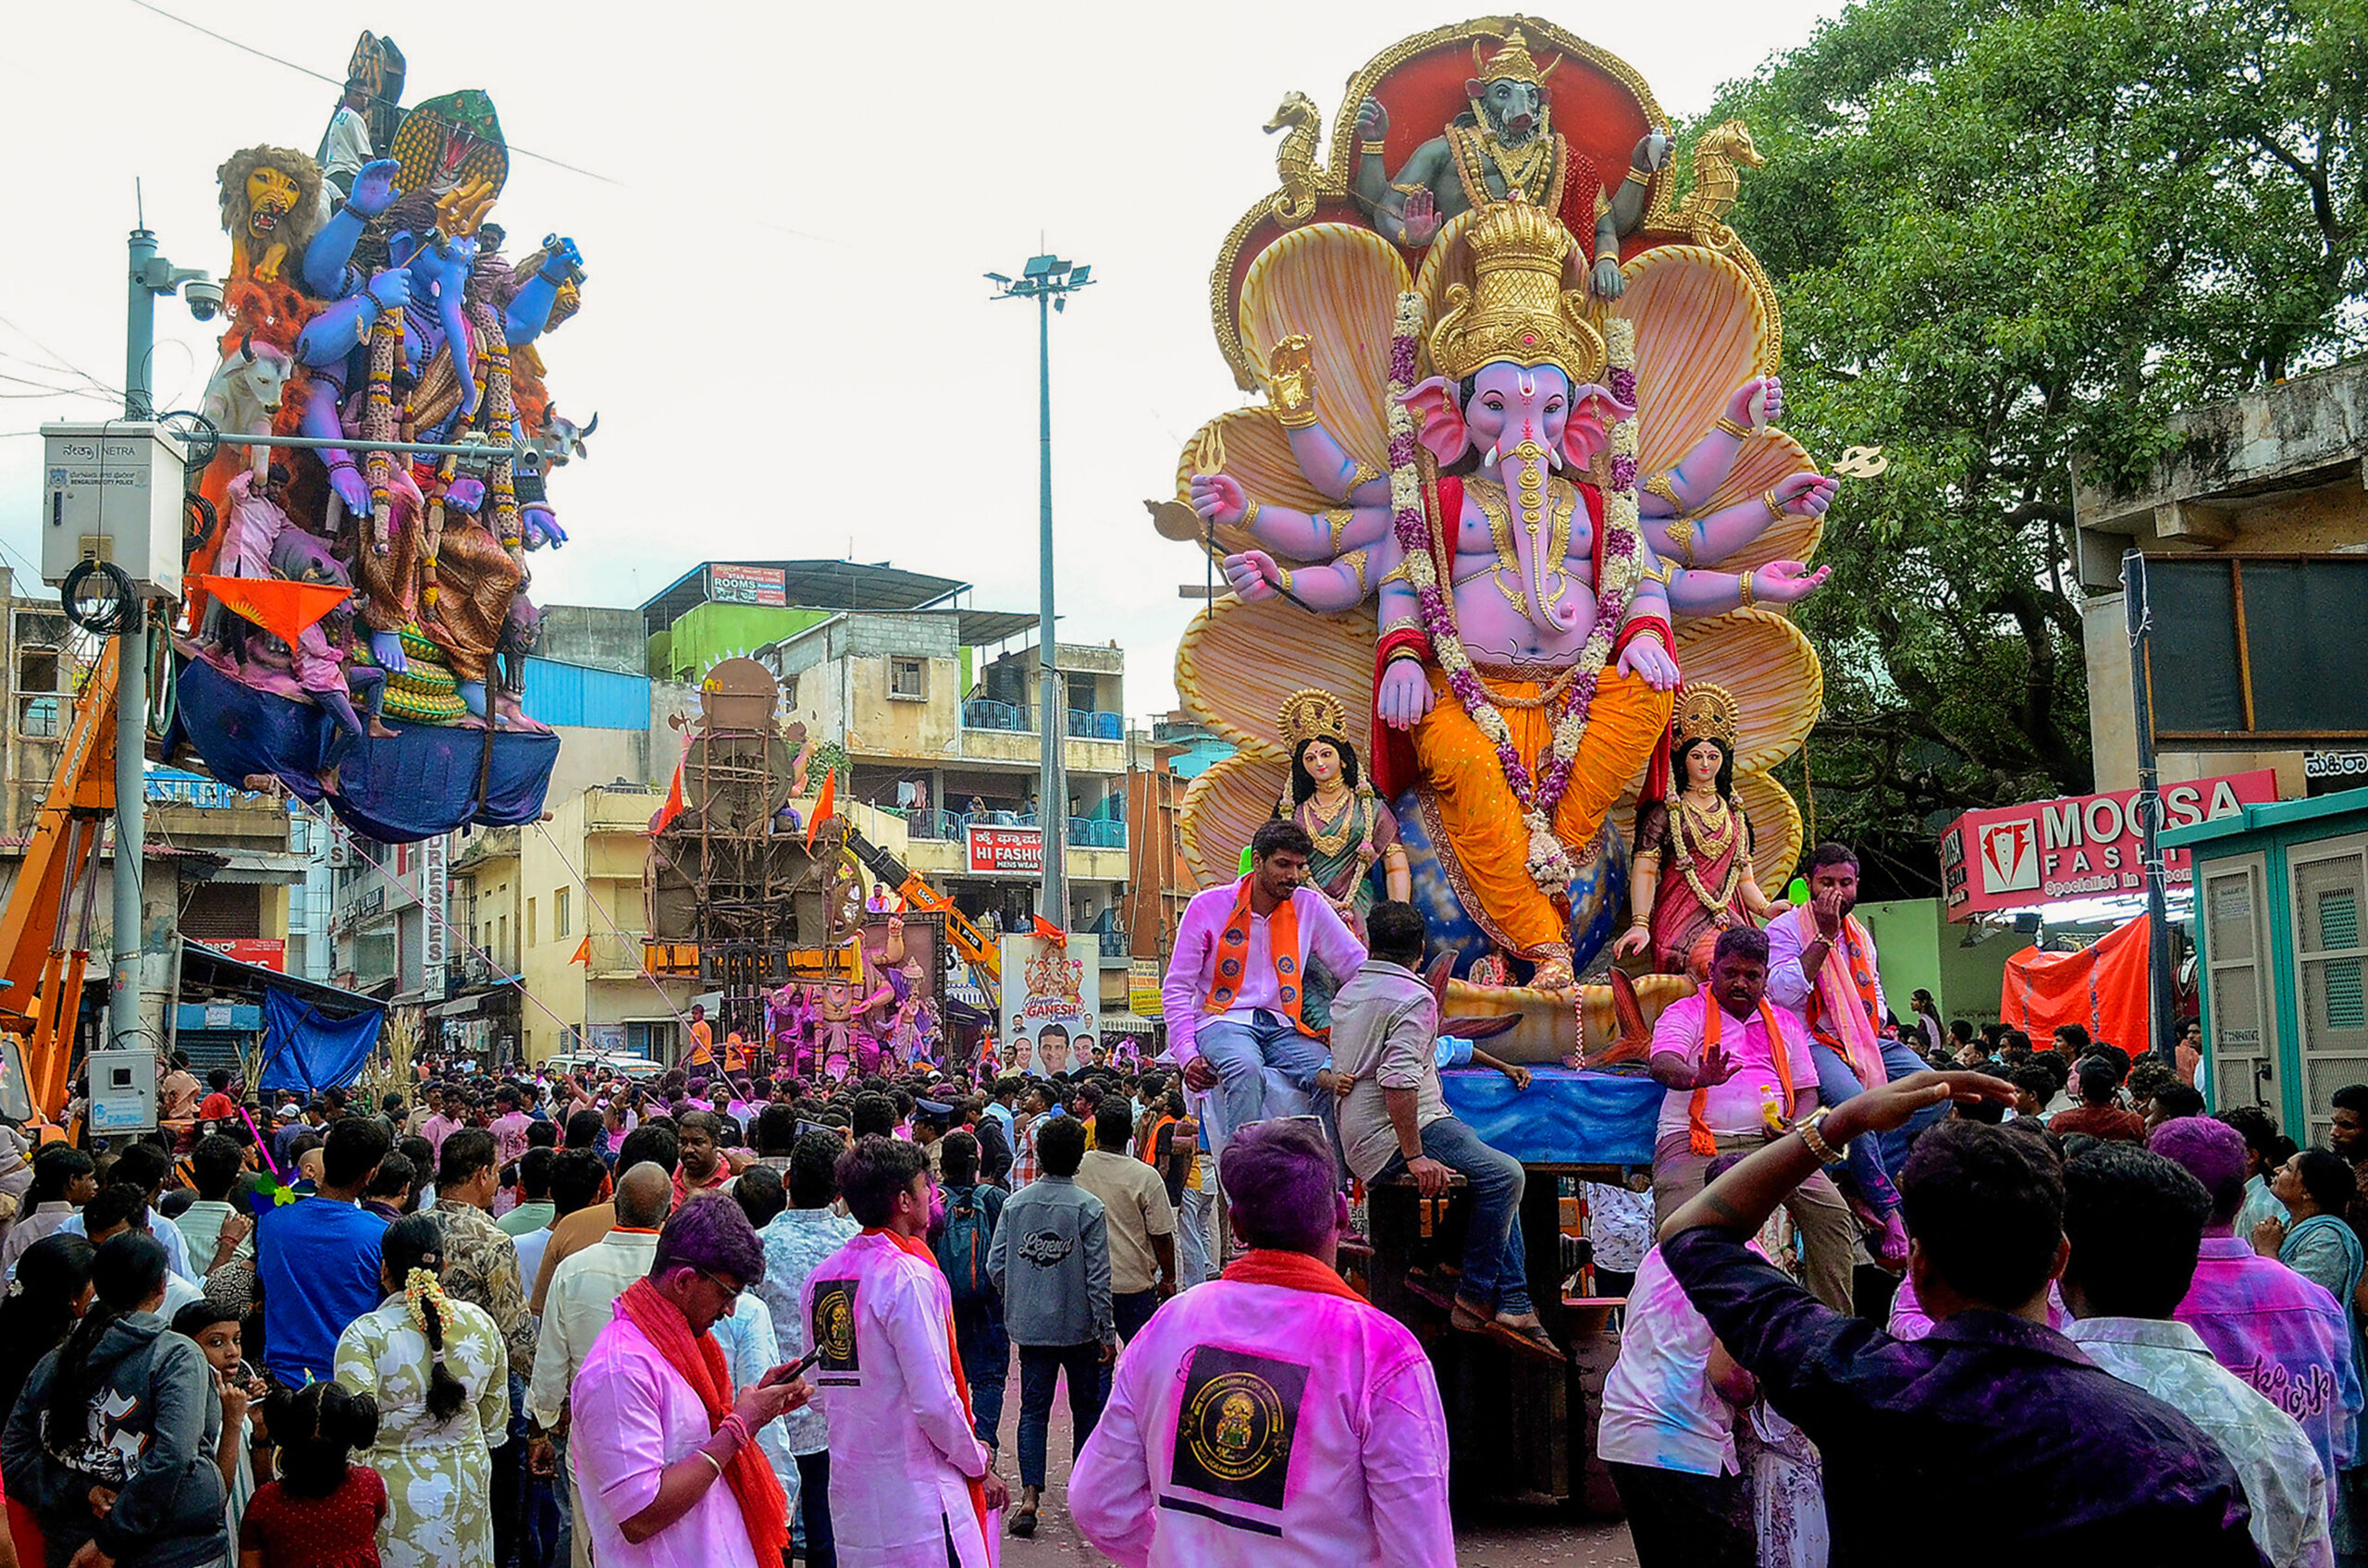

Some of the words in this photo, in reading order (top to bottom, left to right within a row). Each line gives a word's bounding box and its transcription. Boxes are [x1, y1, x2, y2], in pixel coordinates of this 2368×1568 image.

[103, 447, 135, 456] NETRA
[714, 577, 757, 590] ROOMS
[976, 846, 992, 860] HI
[917, 888, 935, 906] ESCO
[1027, 1004, 1077, 1018] GANESH
[1018, 1231, 1074, 1261] Legend
